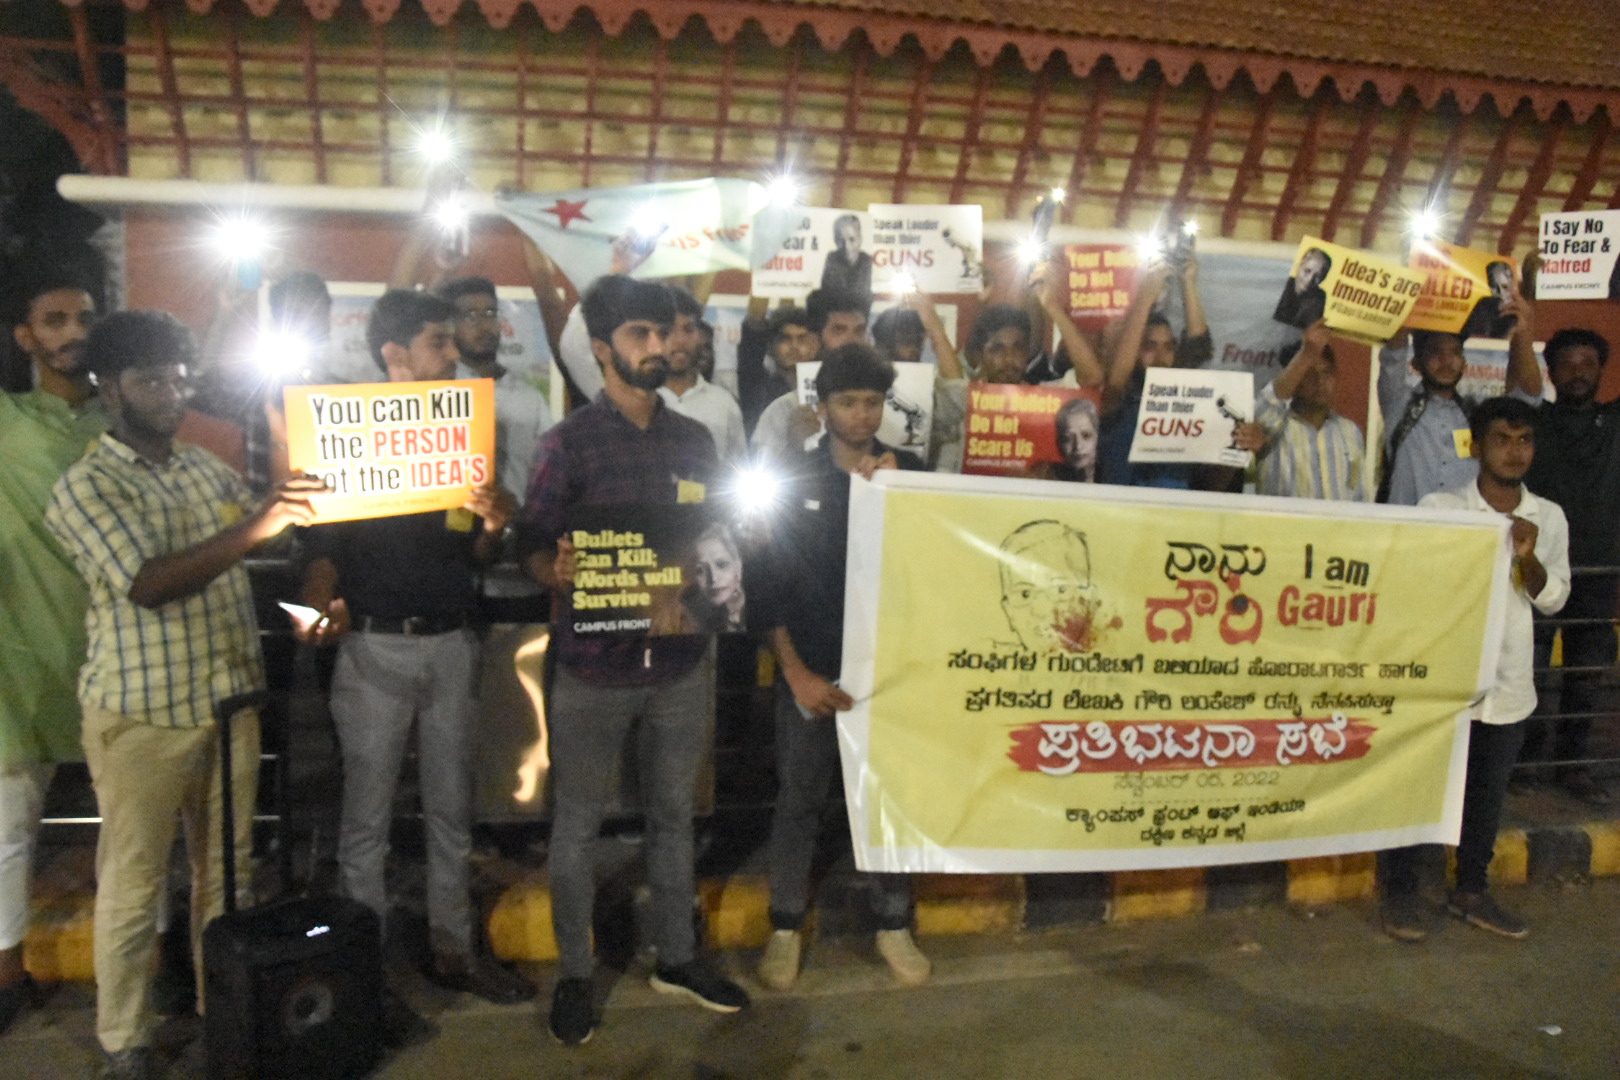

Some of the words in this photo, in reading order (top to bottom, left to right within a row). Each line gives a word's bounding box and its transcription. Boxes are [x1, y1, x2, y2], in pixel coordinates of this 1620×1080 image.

[1544, 220, 1549, 235] I
[1553, 220, 1580, 236] Say
[1585, 218, 1604, 234] No
[782, 237, 806, 250] ear
[1543, 240, 1559, 254] To
[1564, 239, 1596, 254] Fear
[1600, 237, 1611, 253] &
[873, 248, 934, 268] GUNS
[1069, 271, 1088, 289] Do
[1090, 270, 1114, 288] Not
[1340, 257, 1391, 288] Idea's
[1392, 275, 1421, 297] are
[1070, 291, 1110, 308] Scare
[1113, 289, 1130, 307] Us
[1332, 279, 1406, 315] Immortal
[313, 397, 361, 425] You
[372, 397, 421, 423] can
[431, 390, 470, 419] Kill
[971, 390, 1005, 410] Your
[970, 414, 990, 434] Do
[994, 415, 1019, 435] Not
[1141, 417, 1205, 437] GUNS
[320, 433, 363, 460] the
[374, 426, 467, 457] PERSON
[968, 437, 1012, 457] Scare
[1015, 438, 1034, 457] Us
[320, 468, 347, 493] ot
[359, 466, 400, 491] the
[411, 457, 485, 488] IDEA'S
[572, 530, 644, 548] Bullets
[575, 551, 613, 568] Can
[1165, 541, 1266, 581] ನಾನು
[1304, 543, 1313, 579] I
[1325, 556, 1370, 587] am
[574, 569, 639, 589] Words
[644, 567, 683, 586] will
[572, 590, 651, 610] Survive
[1145, 572, 1263, 645] ಗೌರಿ
[1277, 585, 1377, 627] Gauri
[573, 620, 616, 633] CAMPUS
[618, 619, 652, 632] FRONT
[1037, 720, 1256, 776] ಪ್ರತಿಭಟನಾ
[1276, 711, 1348, 766] ಸಭೆ
[1232, 770, 1281, 786] 2022
